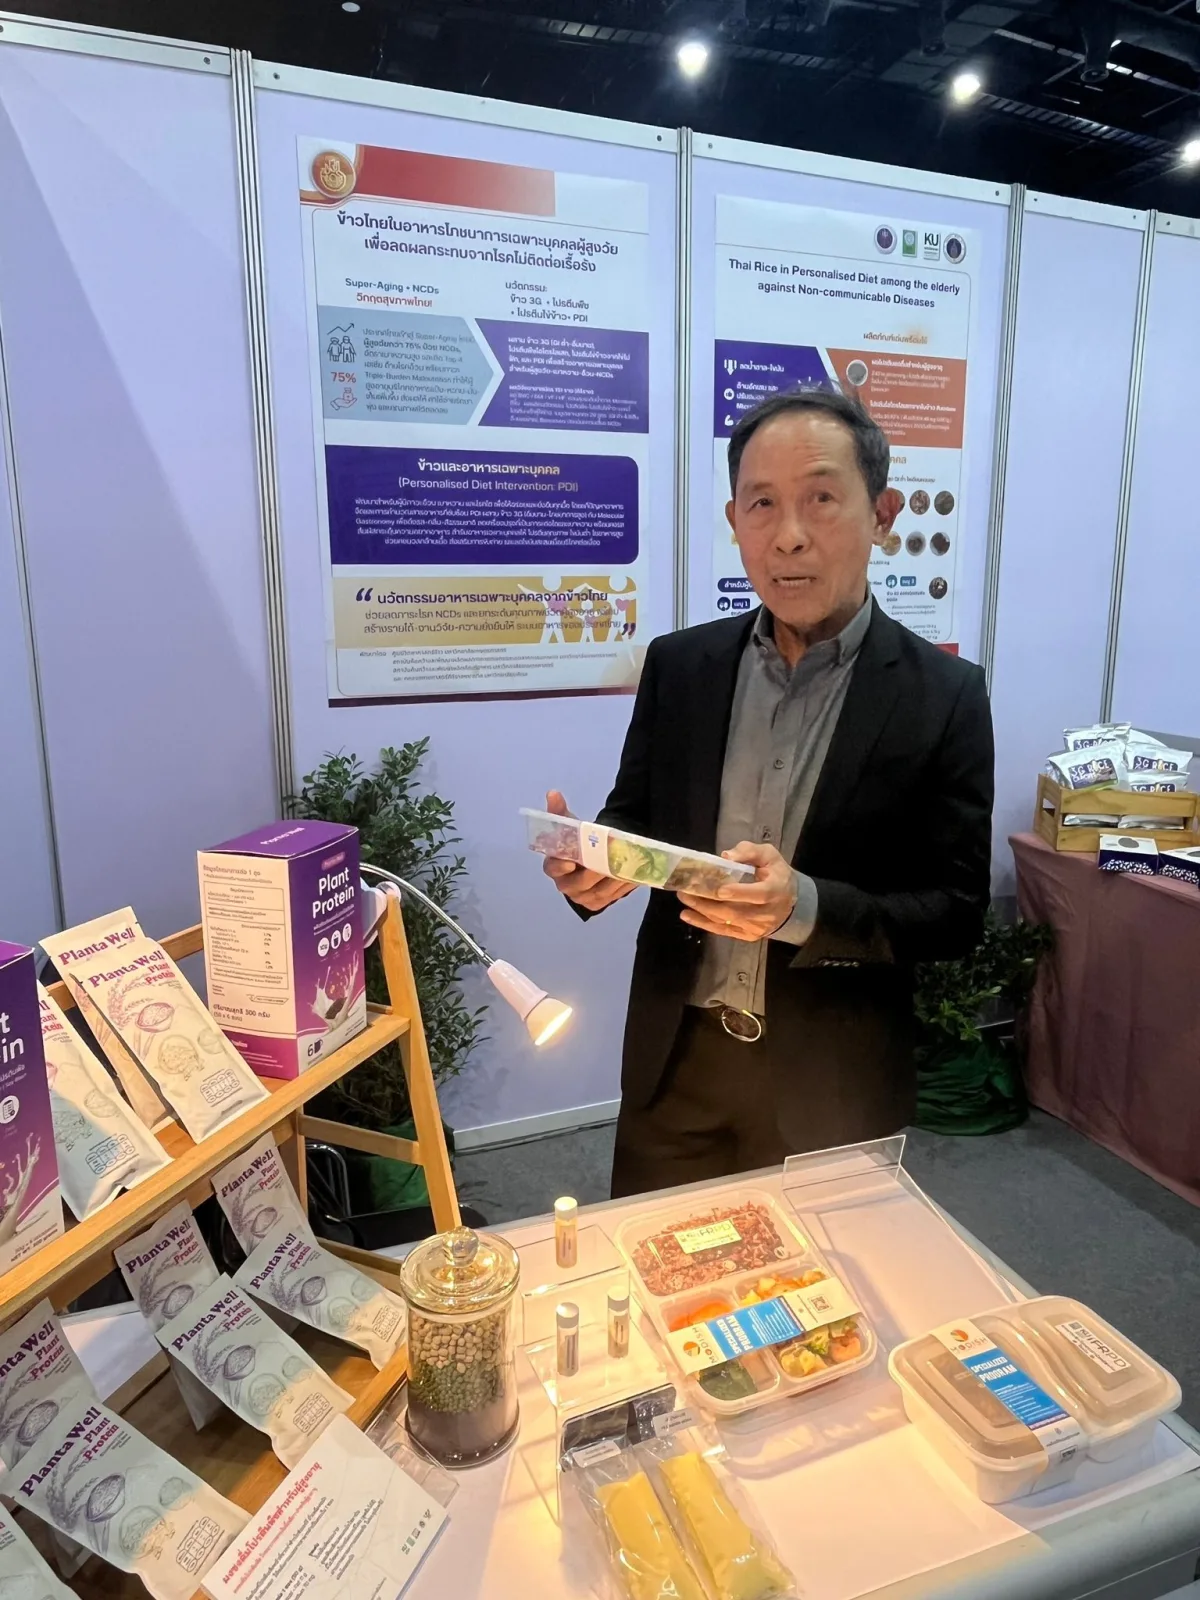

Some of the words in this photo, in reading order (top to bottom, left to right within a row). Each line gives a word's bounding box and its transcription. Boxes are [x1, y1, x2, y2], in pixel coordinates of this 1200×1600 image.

[924, 232, 939, 246] KU
[345, 278, 404, 293] Super-Aging
[412, 284, 439, 295] NCDs
[729, 258, 752, 271] Thai
[754, 261, 778, 274] Rice
[780, 264, 790, 275] in
[792, 266, 856, 282] Personalised
[858, 273, 878, 285] Diet
[880, 278, 911, 291] among
[913, 280, 928, 290] the
[930, 282, 960, 296] elderly
[758, 281, 796, 294] against
[798, 285, 891, 303] Non-communicable
[893, 294, 935, 308] Diseases
[331, 371, 357, 384] 75%
[418, 458, 560, 478] ข้าวและอาหารเฉพาะบุคคล
[398, 477, 469, 490] (Personalised
[471, 479, 492, 490] Diet
[378, 589, 608, 606] นวัตกรรมอาหารเฉพาะบุคคลจากข้าวไทย
[436, 610, 462, 619] NCDs
[319, 866, 350, 896] Plant
[312, 885, 355, 919] Protein
[145, 970, 176, 986] Protein
[148, 961, 171, 975] Plant
[307, 1043, 314, 1057] 6
[261, 1160, 277, 1177] Plant
[259, 1169, 280, 1192] Protein
[177, 1231, 195, 1251] Plant
[288, 1240, 304, 1259] Plant
[174, 1241, 199, 1265] Protein
[290, 1244, 311, 1270] Protein
[224, 1299, 246, 1319] Plant
[223, 1307, 252, 1332] Protein
[35, 1335, 60, 1361] Plant
[30, 1344, 65, 1380] Protein
[83, 1417, 111, 1445] Plant
[82, 1423, 119, 1463] Protein
